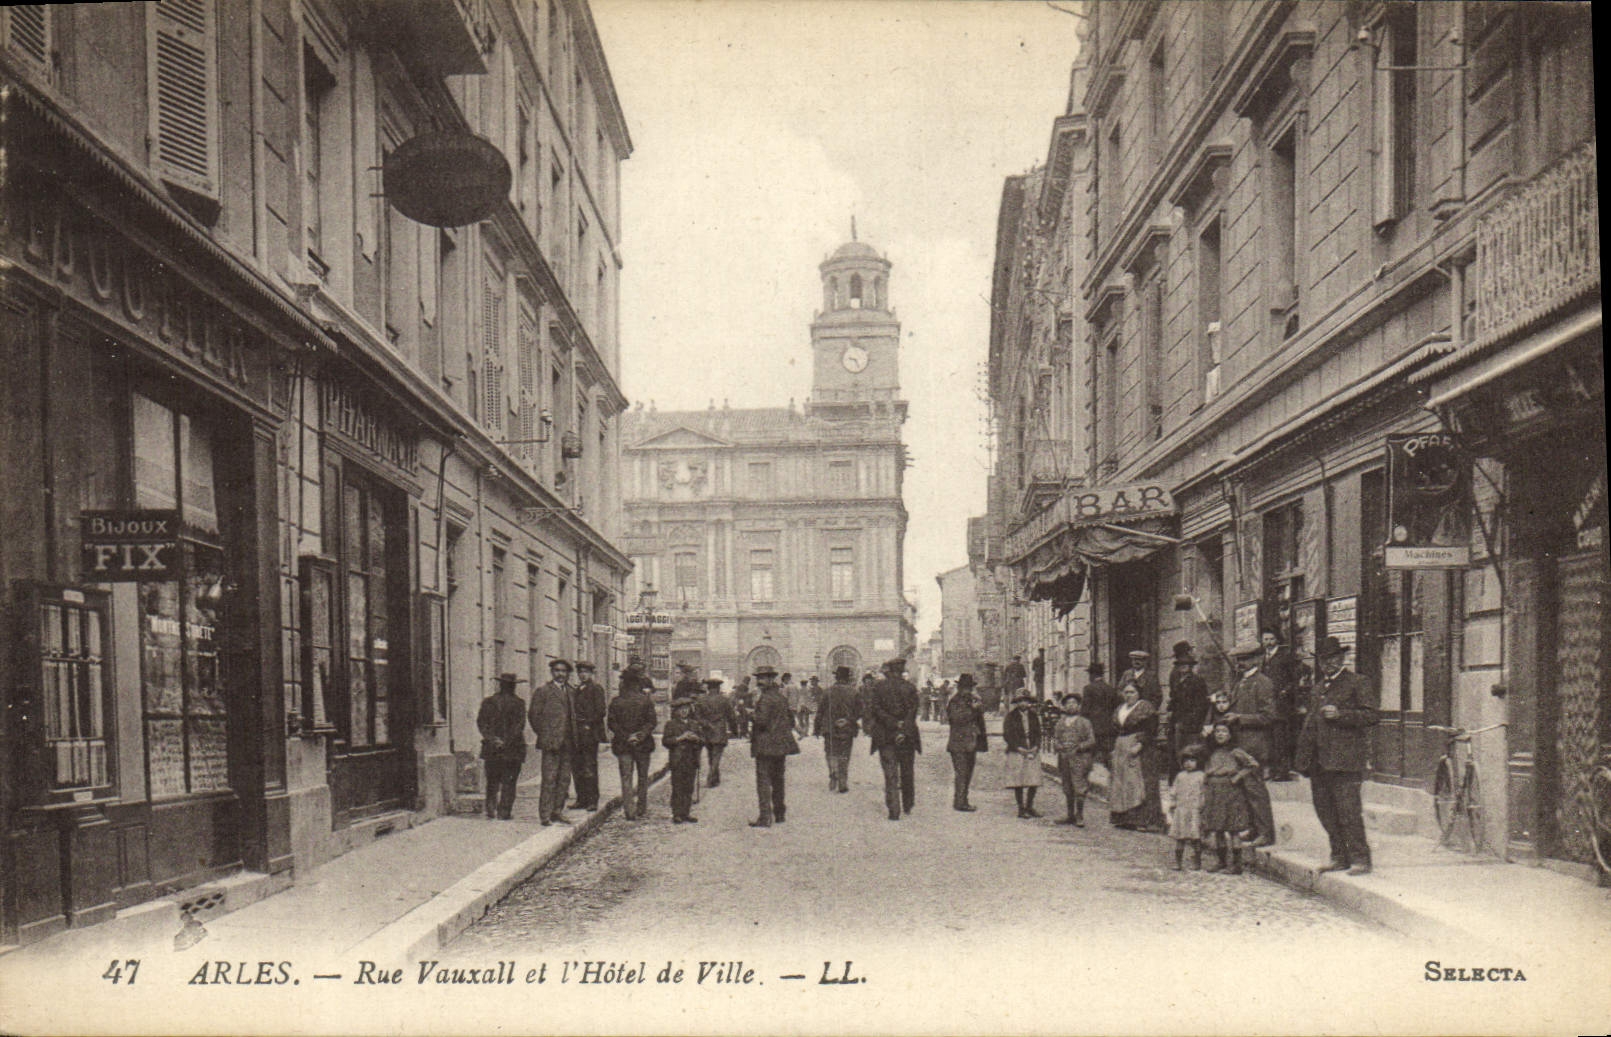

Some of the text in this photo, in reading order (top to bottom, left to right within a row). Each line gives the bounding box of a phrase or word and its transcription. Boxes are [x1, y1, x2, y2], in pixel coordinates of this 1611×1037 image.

[1403, 434, 1464, 458] PFAF
[1073, 486, 1170, 521] BAR
[91, 518, 168, 535] BIJOUX
[1405, 549, 1454, 560] Machines
